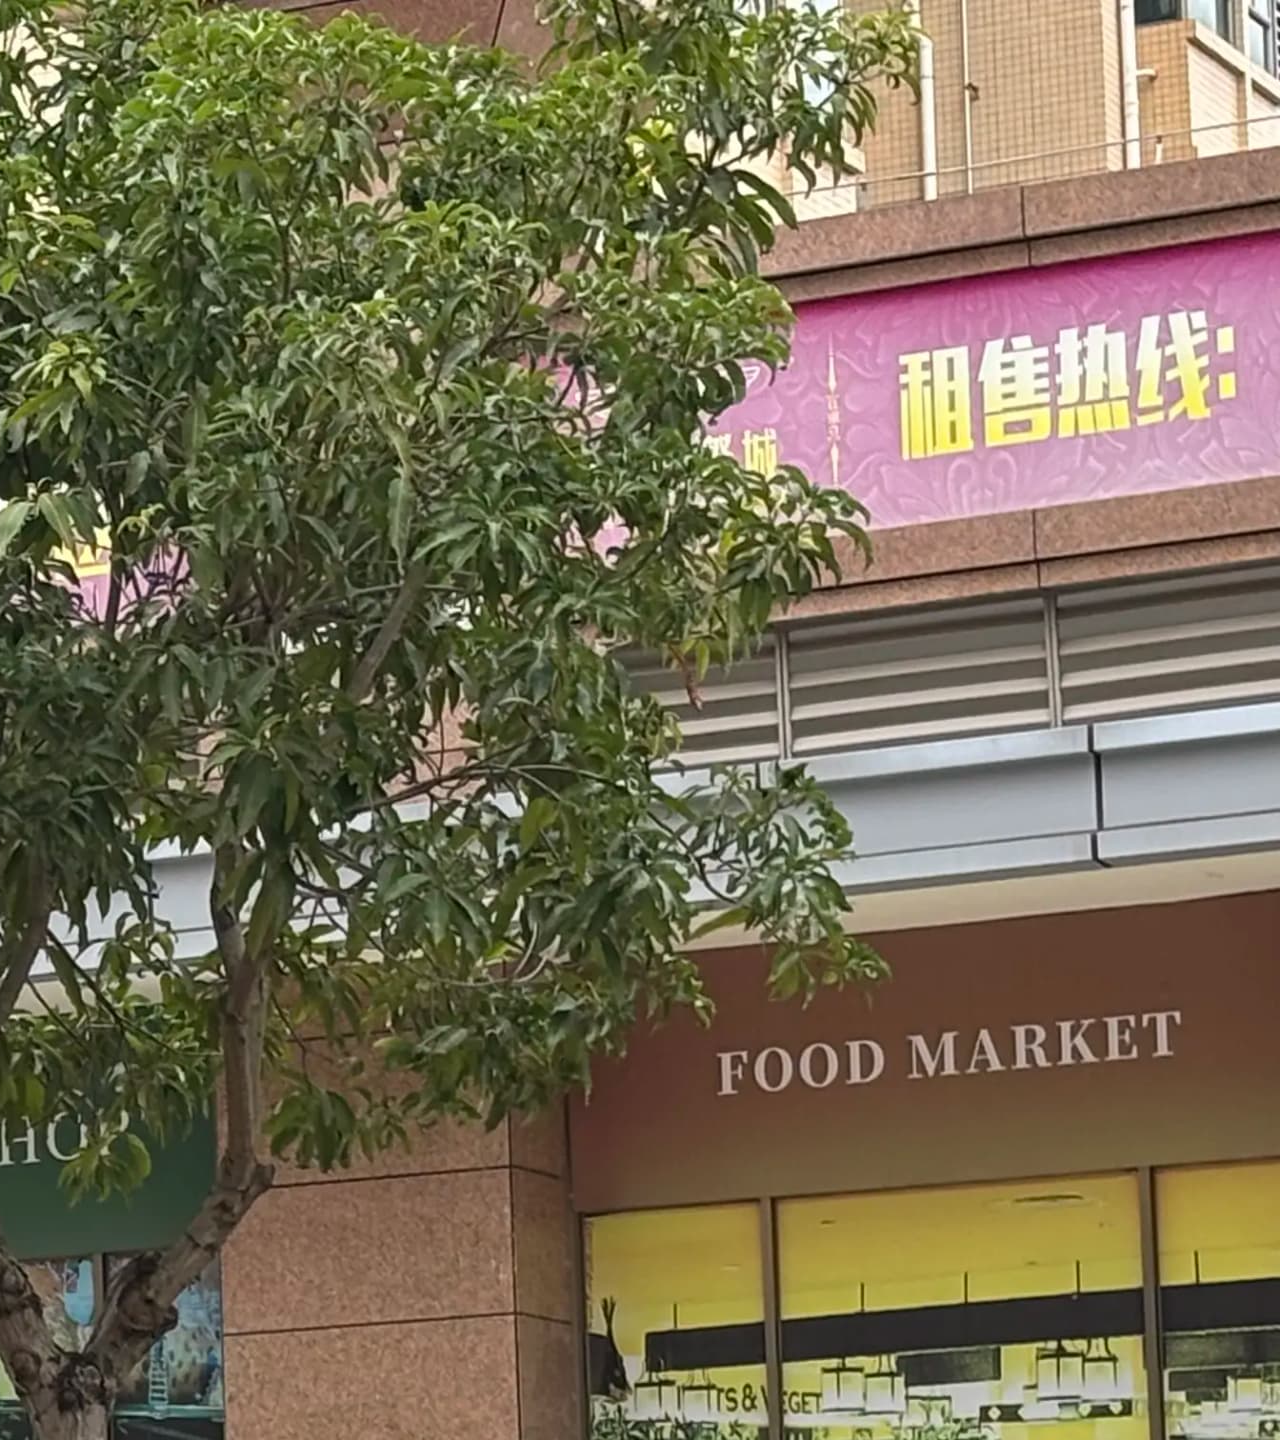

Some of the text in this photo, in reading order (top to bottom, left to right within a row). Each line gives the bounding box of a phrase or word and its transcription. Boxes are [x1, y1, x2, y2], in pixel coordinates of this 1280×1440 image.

[898, 310, 1236, 461] 租售热线:
[717, 1010, 1181, 1096] FOOD MARKET
